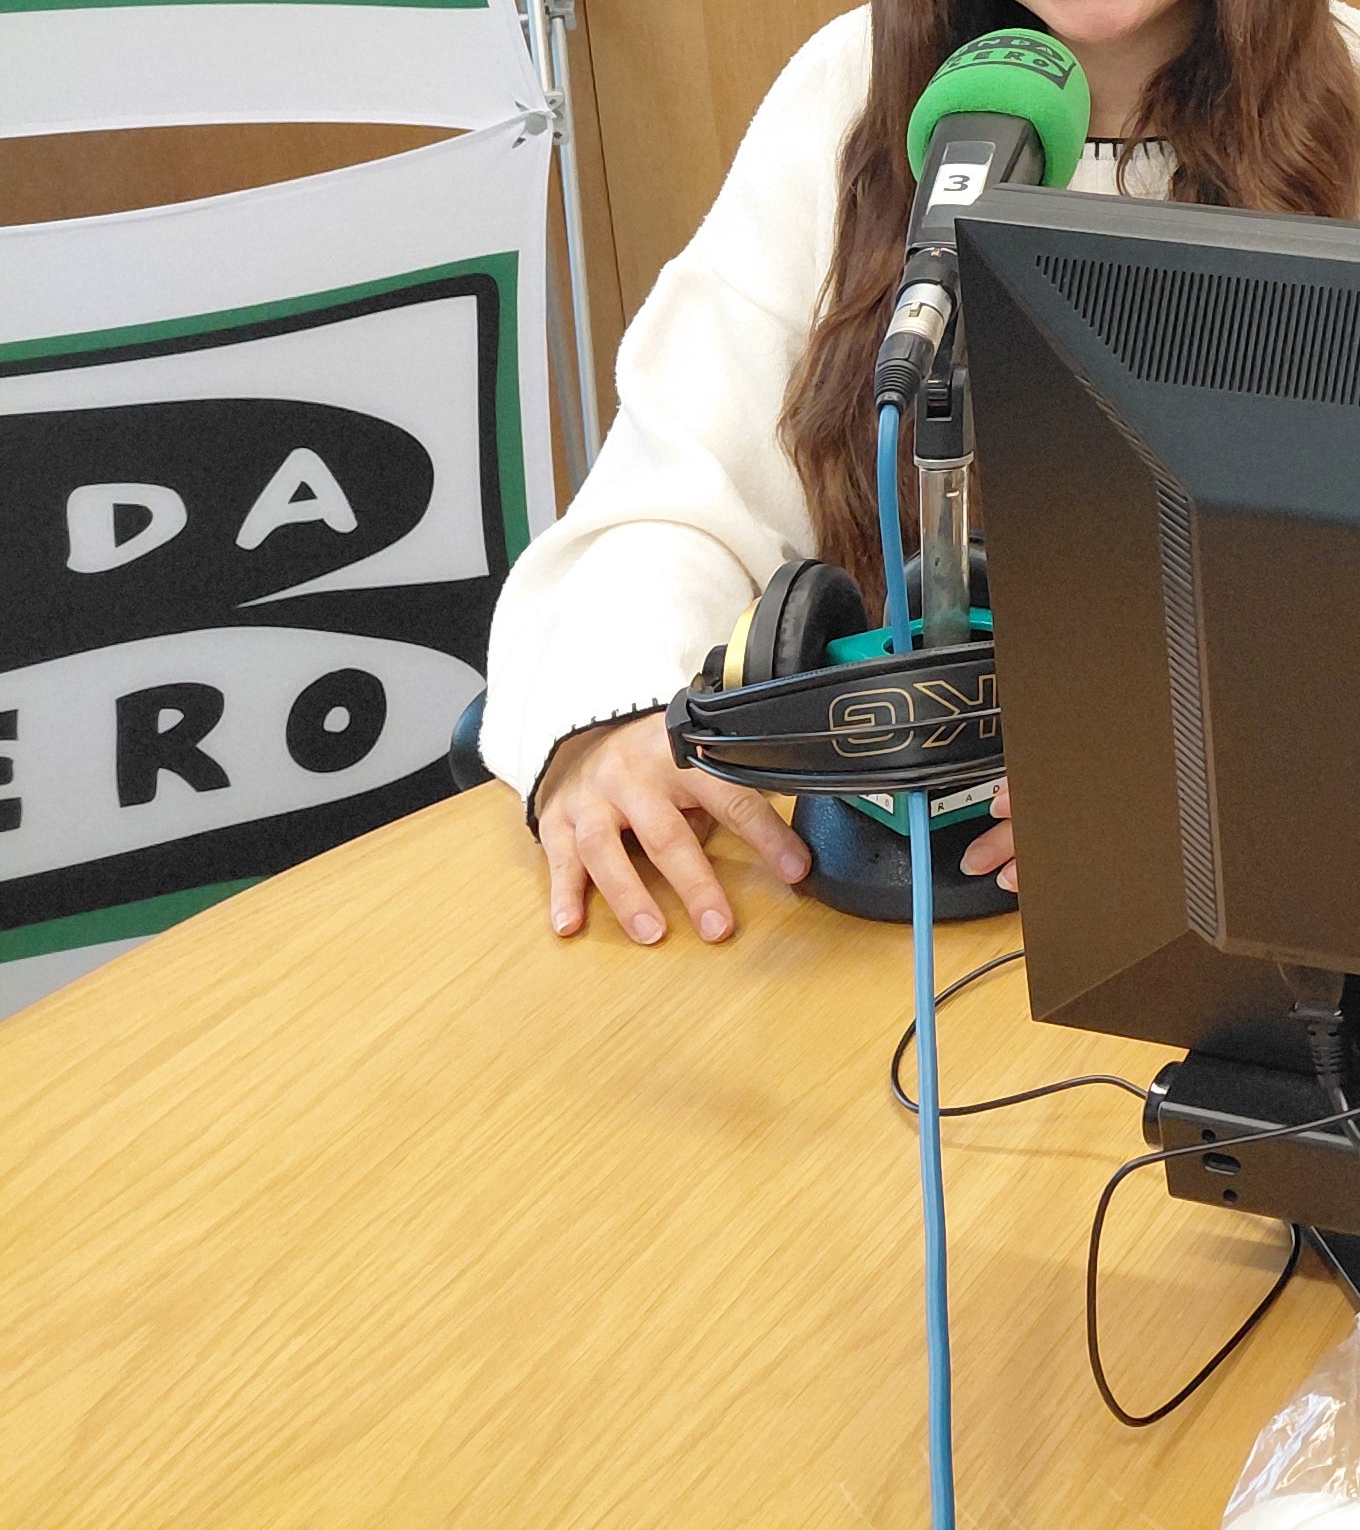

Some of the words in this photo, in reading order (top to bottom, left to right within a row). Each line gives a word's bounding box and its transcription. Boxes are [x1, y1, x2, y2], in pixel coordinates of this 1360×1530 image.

[944, 174, 971, 192] 3
[828, 673, 997, 758] KG
[937, 784, 1001, 812] RAD
